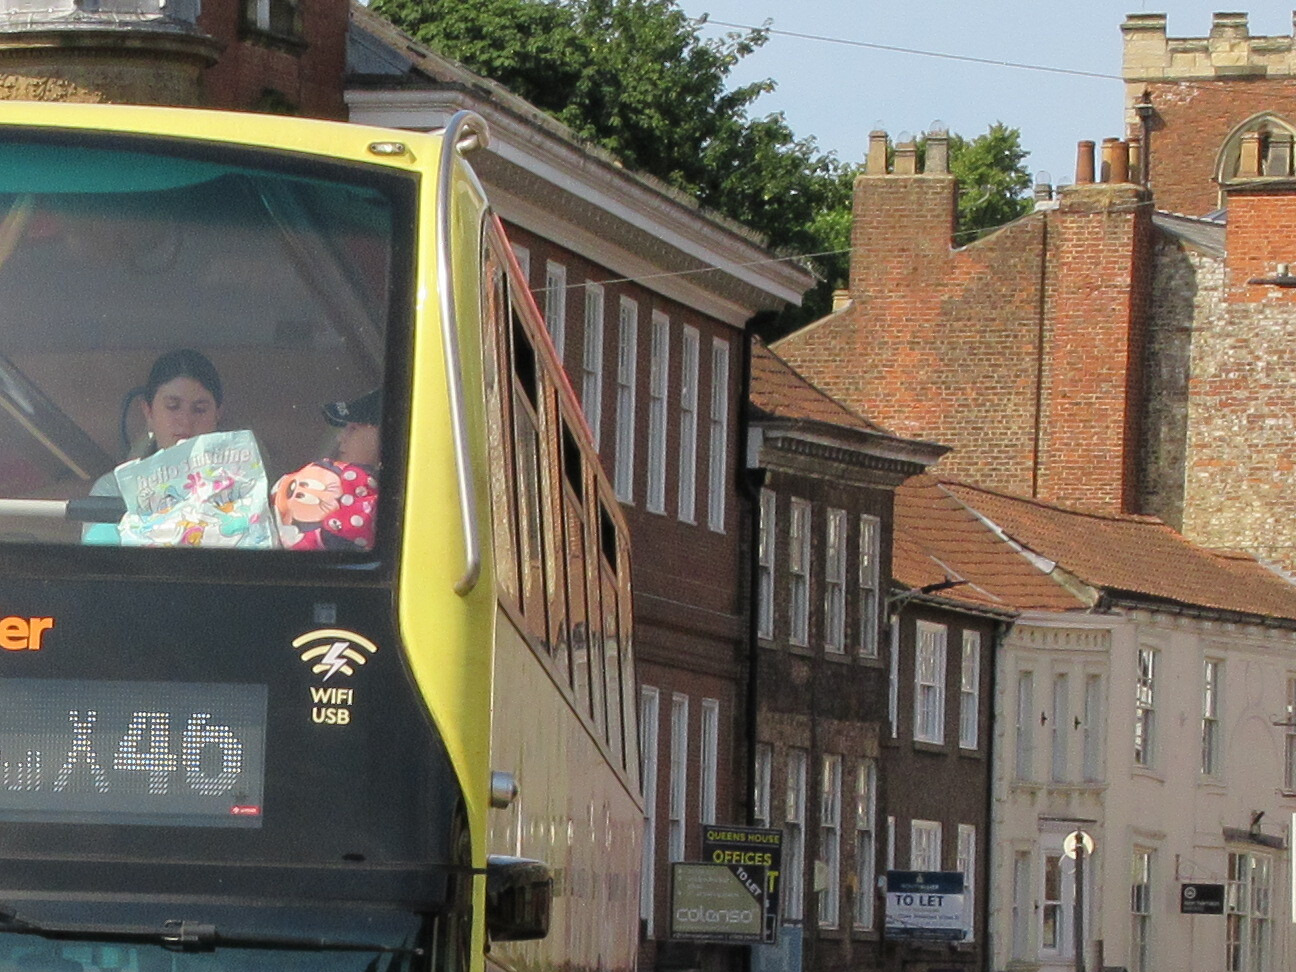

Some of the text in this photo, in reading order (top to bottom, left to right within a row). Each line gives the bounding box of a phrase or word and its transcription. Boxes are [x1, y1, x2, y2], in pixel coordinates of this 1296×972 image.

[310, 687, 354, 705] WIFI
[312, 707, 350, 725] USB
[54, 709, 244, 796] X46
[707, 831, 780, 844] QUEENS HOUSE
[713, 850, 772, 866] OFFICES
[736, 867, 762, 896] TO LET
[895, 894, 944, 907] TO LET
